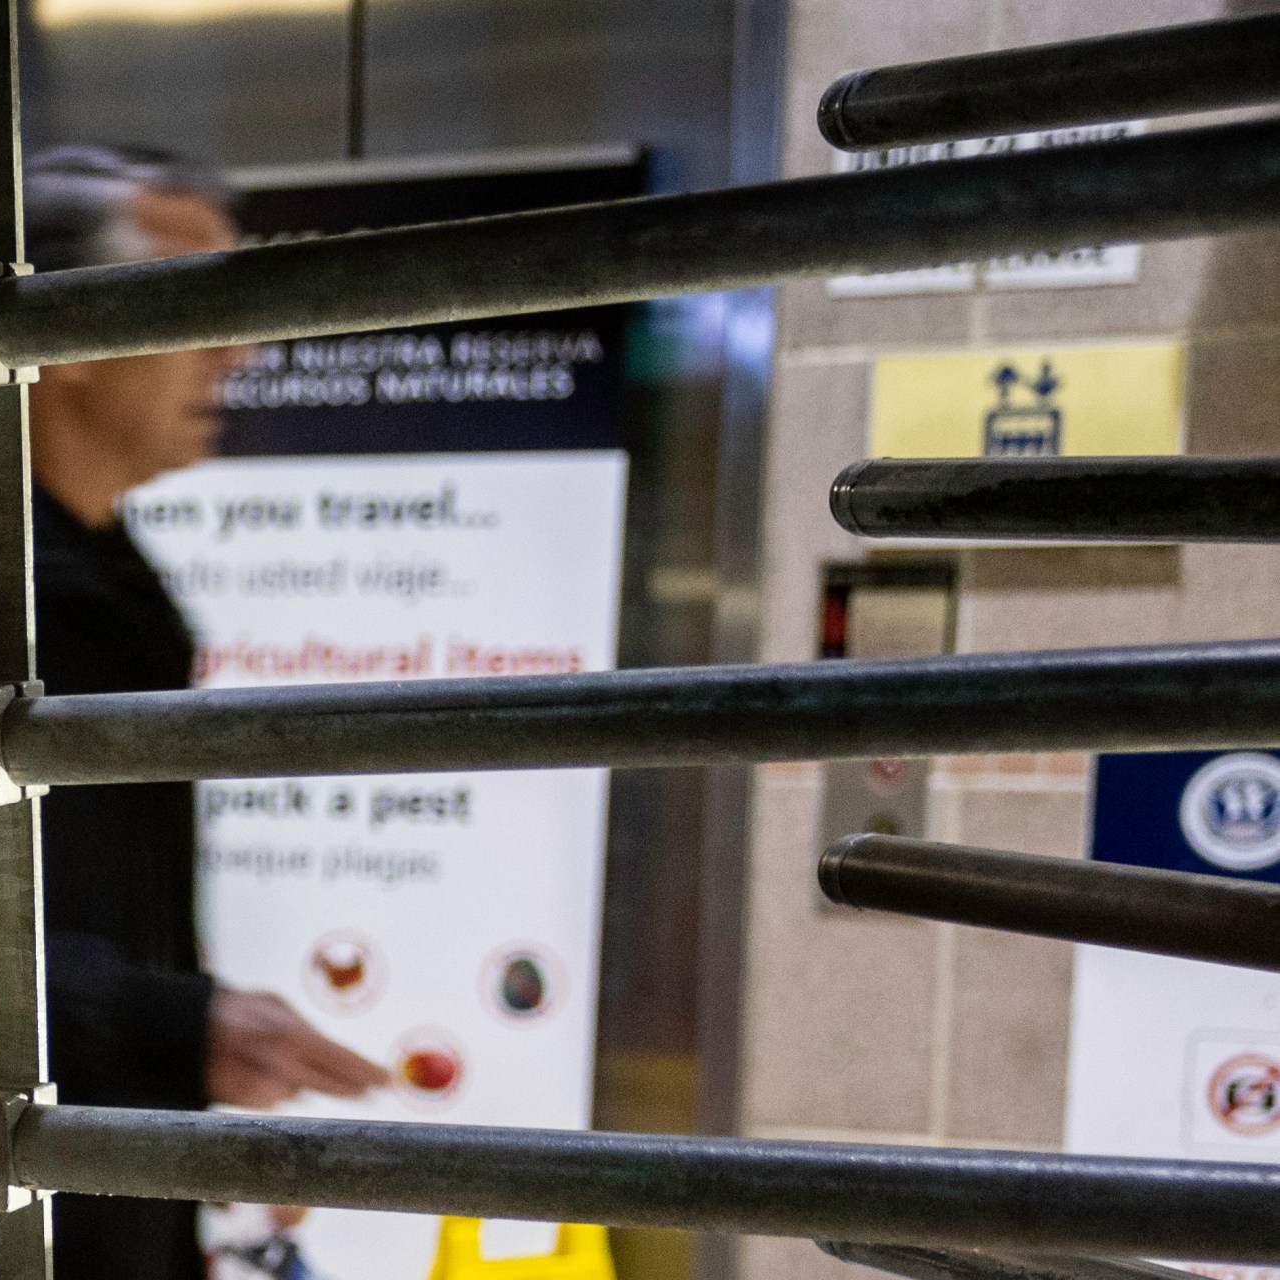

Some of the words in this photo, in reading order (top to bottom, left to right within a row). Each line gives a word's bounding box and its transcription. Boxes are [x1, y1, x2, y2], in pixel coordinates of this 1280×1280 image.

[292, 333, 443, 373] NUESTRA
[450, 329, 604, 368] RESERVA
[374, 361, 576, 402] NATURALES
[212, 496, 300, 542] you
[193, 630, 432, 682] gricultural
[445, 626, 584, 676] items
[203, 777, 311, 830] pack
[327, 786, 354, 821] a
[367, 782, 472, 834] pest
